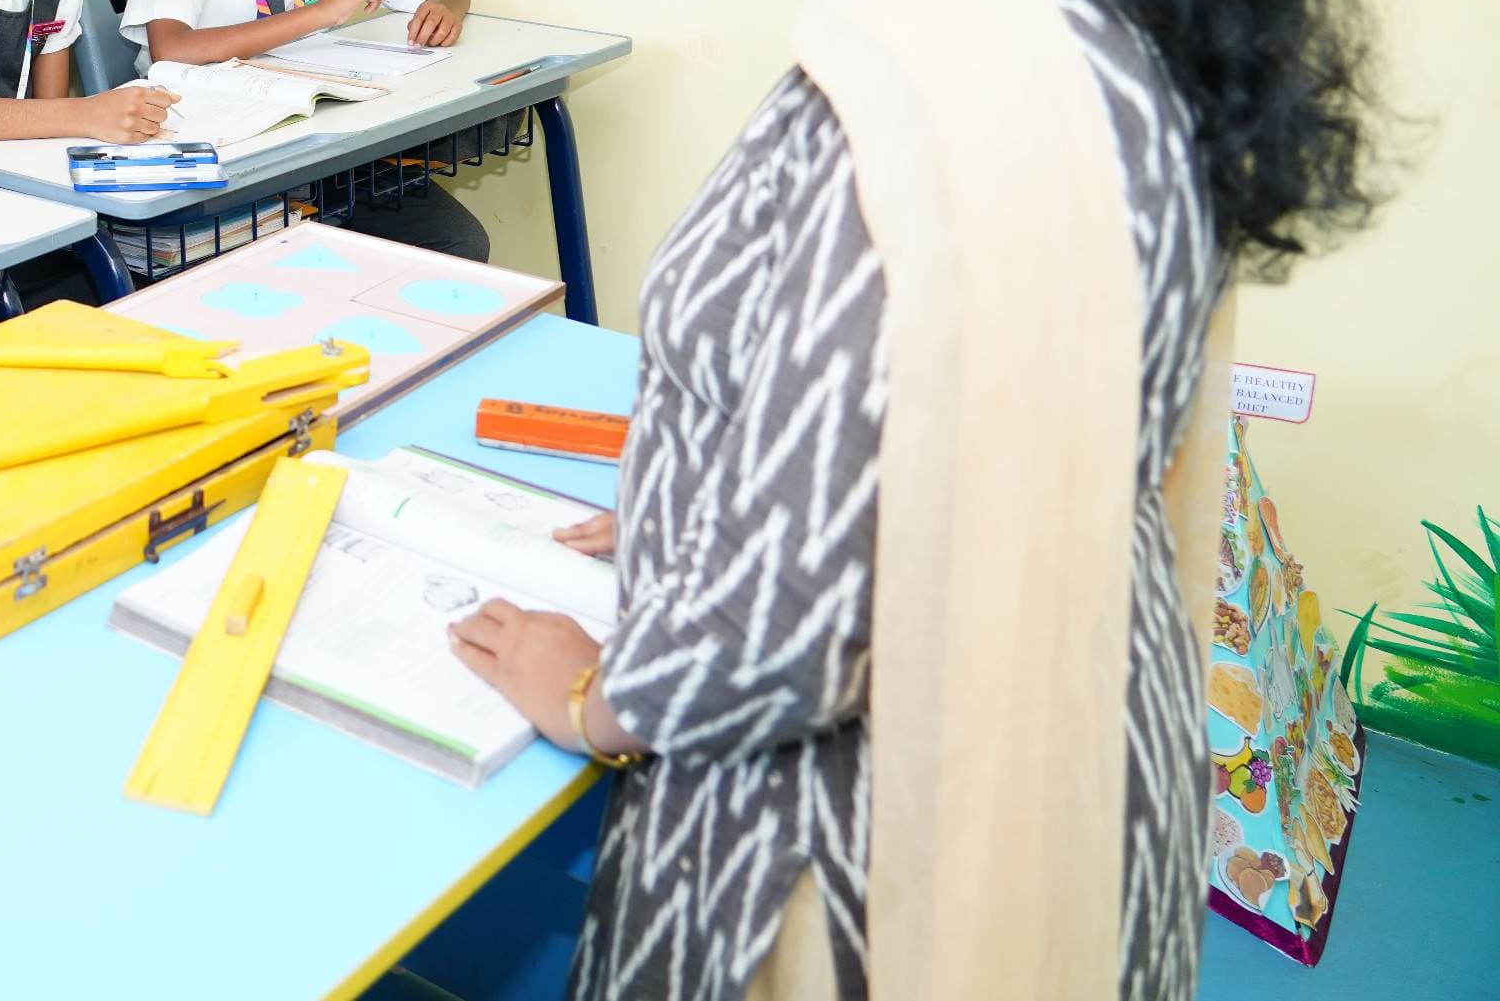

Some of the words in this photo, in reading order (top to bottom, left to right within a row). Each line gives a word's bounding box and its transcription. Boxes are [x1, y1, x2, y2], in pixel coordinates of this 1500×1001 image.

[1244, 375, 1308, 392] HEALTHY
[1236, 388, 1304, 406] BALANCED
[1237, 401, 1268, 413] DIET
